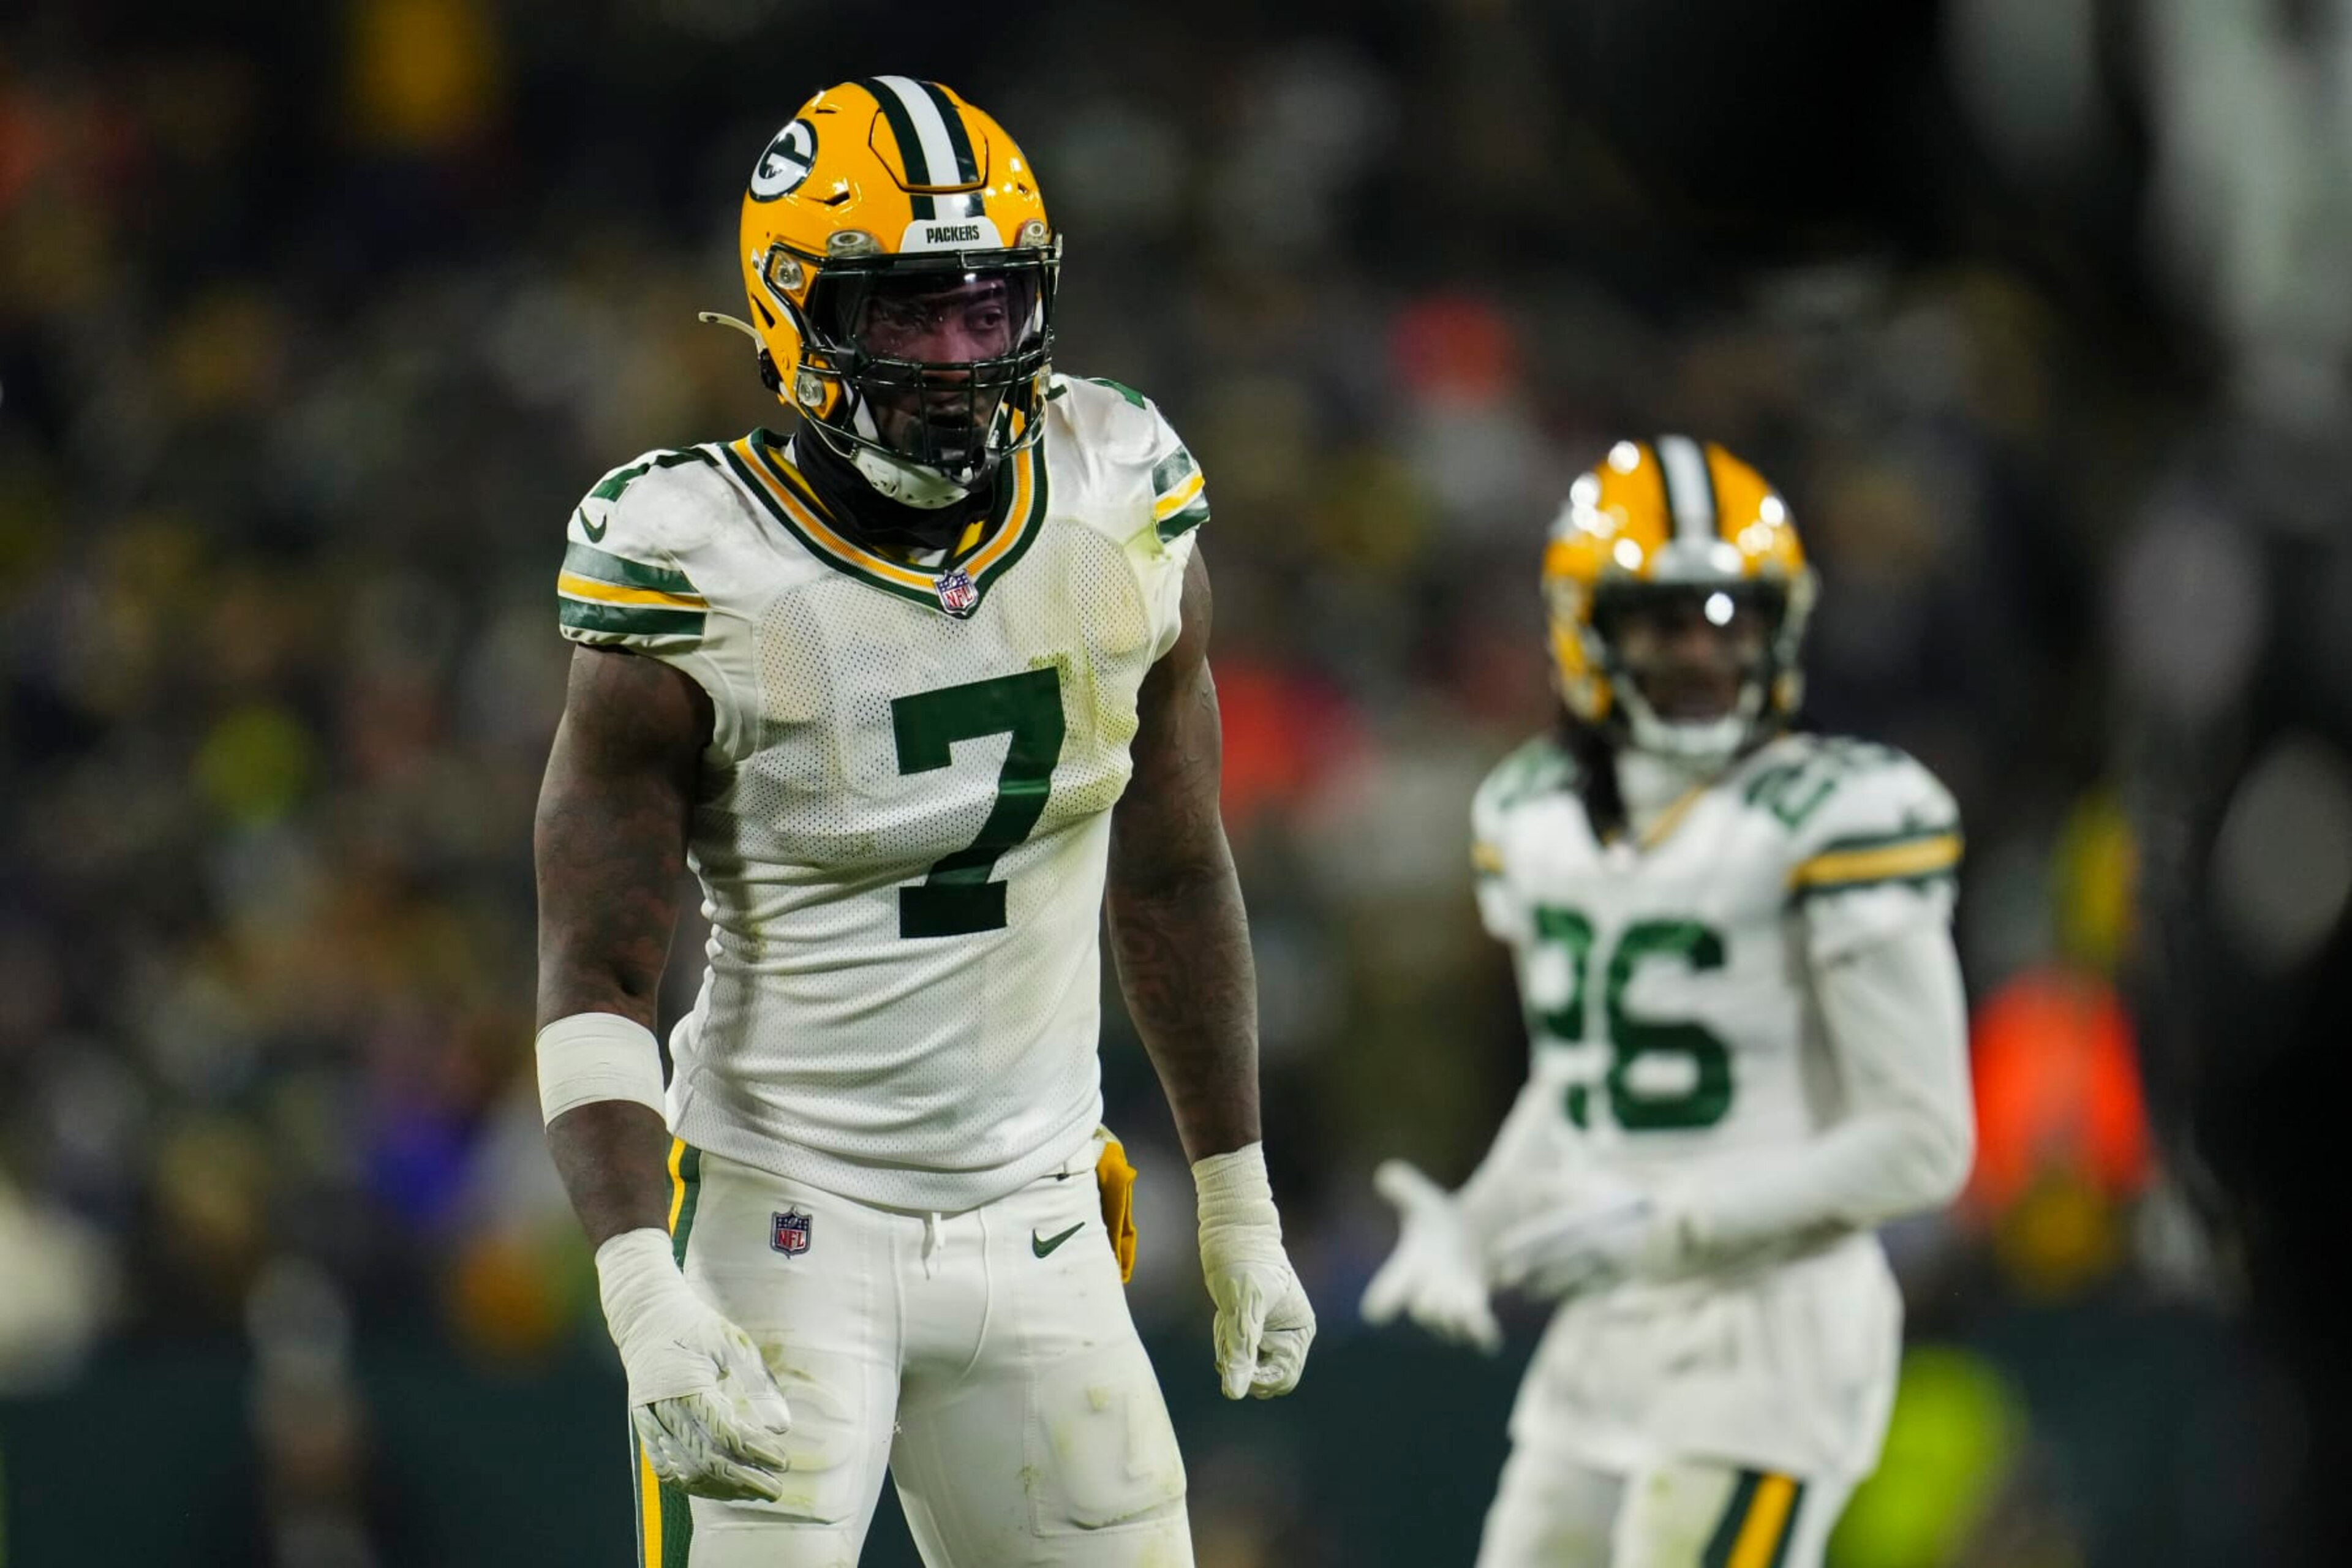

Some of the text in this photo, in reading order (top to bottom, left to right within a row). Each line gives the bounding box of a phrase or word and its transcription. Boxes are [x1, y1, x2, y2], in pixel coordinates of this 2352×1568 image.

[925, 225, 980, 244] PACKERS
[945, 586, 973, 608] NFL
[891, 666, 1066, 938] 7
[778, 1229, 804, 1249] NFL
